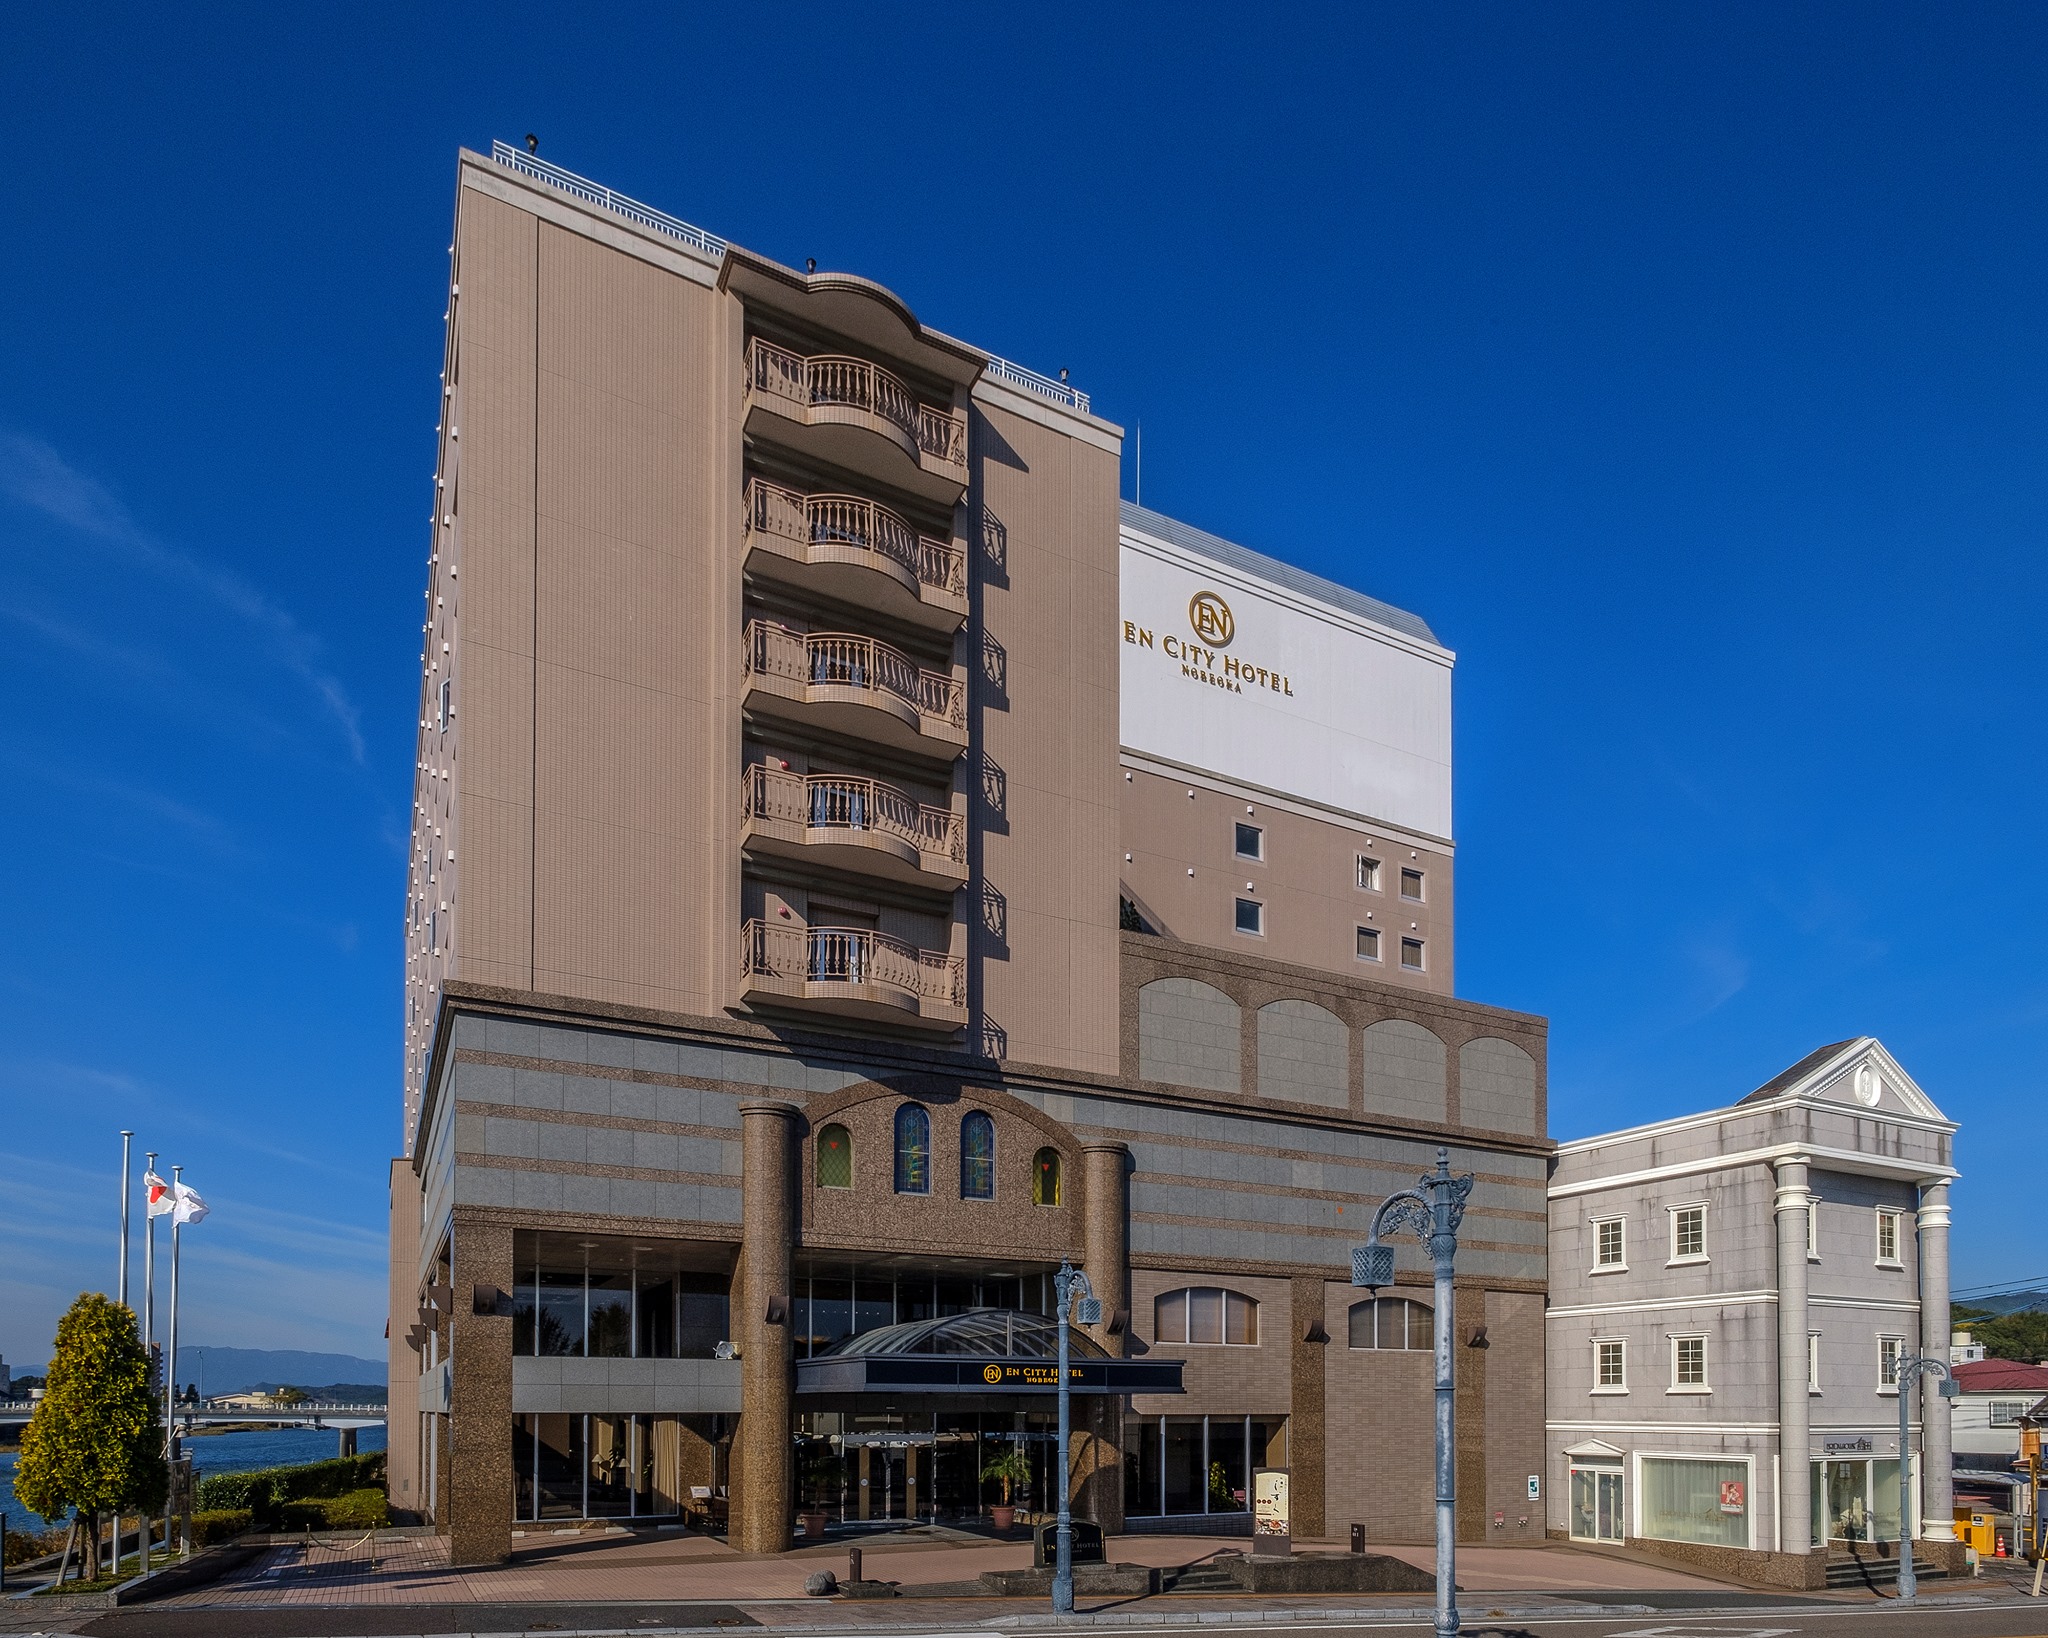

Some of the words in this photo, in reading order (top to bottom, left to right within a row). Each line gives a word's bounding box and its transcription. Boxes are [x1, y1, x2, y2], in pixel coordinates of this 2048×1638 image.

[1123, 620, 1154, 650] EN
[1162, 635, 1215, 670] CITY
[1223, 654, 1294, 697] HOTEL
[1181, 663, 1242, 695] NOBEOKA
[1006, 1367, 1020, 1376] EN
[1023, 1367, 1048, 1377] CITY
[1050, 1368, 1084, 1377] HEL
[1076, 1541, 1100, 1549] HOTEL
